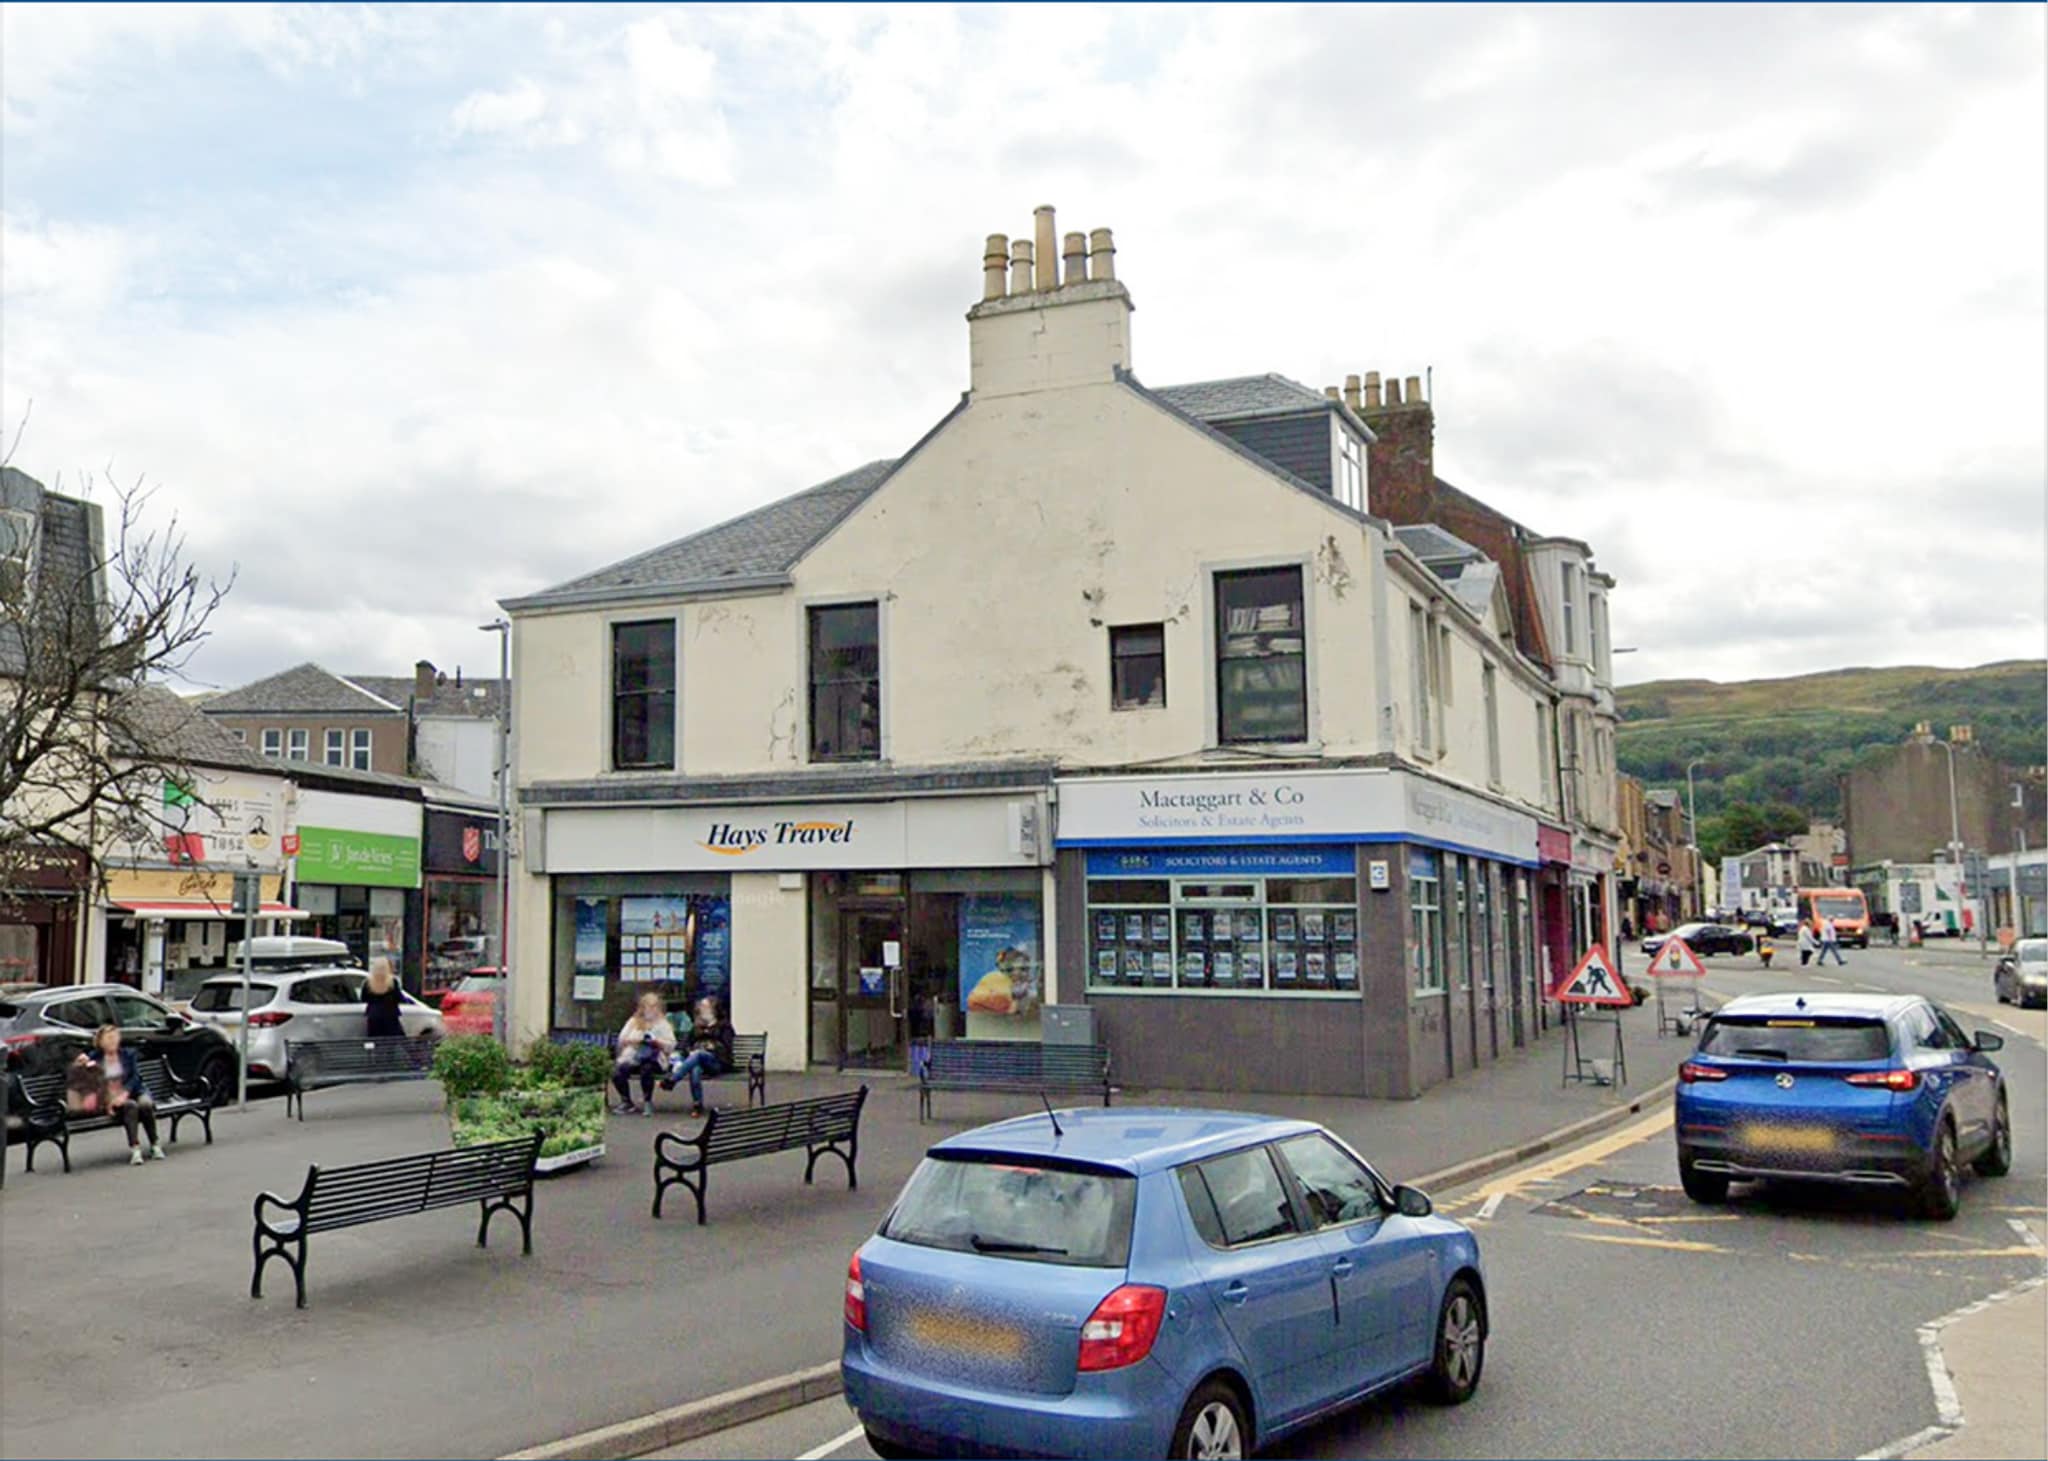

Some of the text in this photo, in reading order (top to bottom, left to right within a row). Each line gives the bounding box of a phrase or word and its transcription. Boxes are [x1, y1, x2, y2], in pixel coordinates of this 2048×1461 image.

[1140, 785, 1304, 812] Mactaggart & Co
[1139, 813, 1304, 828] Solicitors & Estate Agents
[708, 820, 853, 850] Hays Travel
[1165, 854, 1322, 867] SOLICITORS & ESTATE AGENTS
